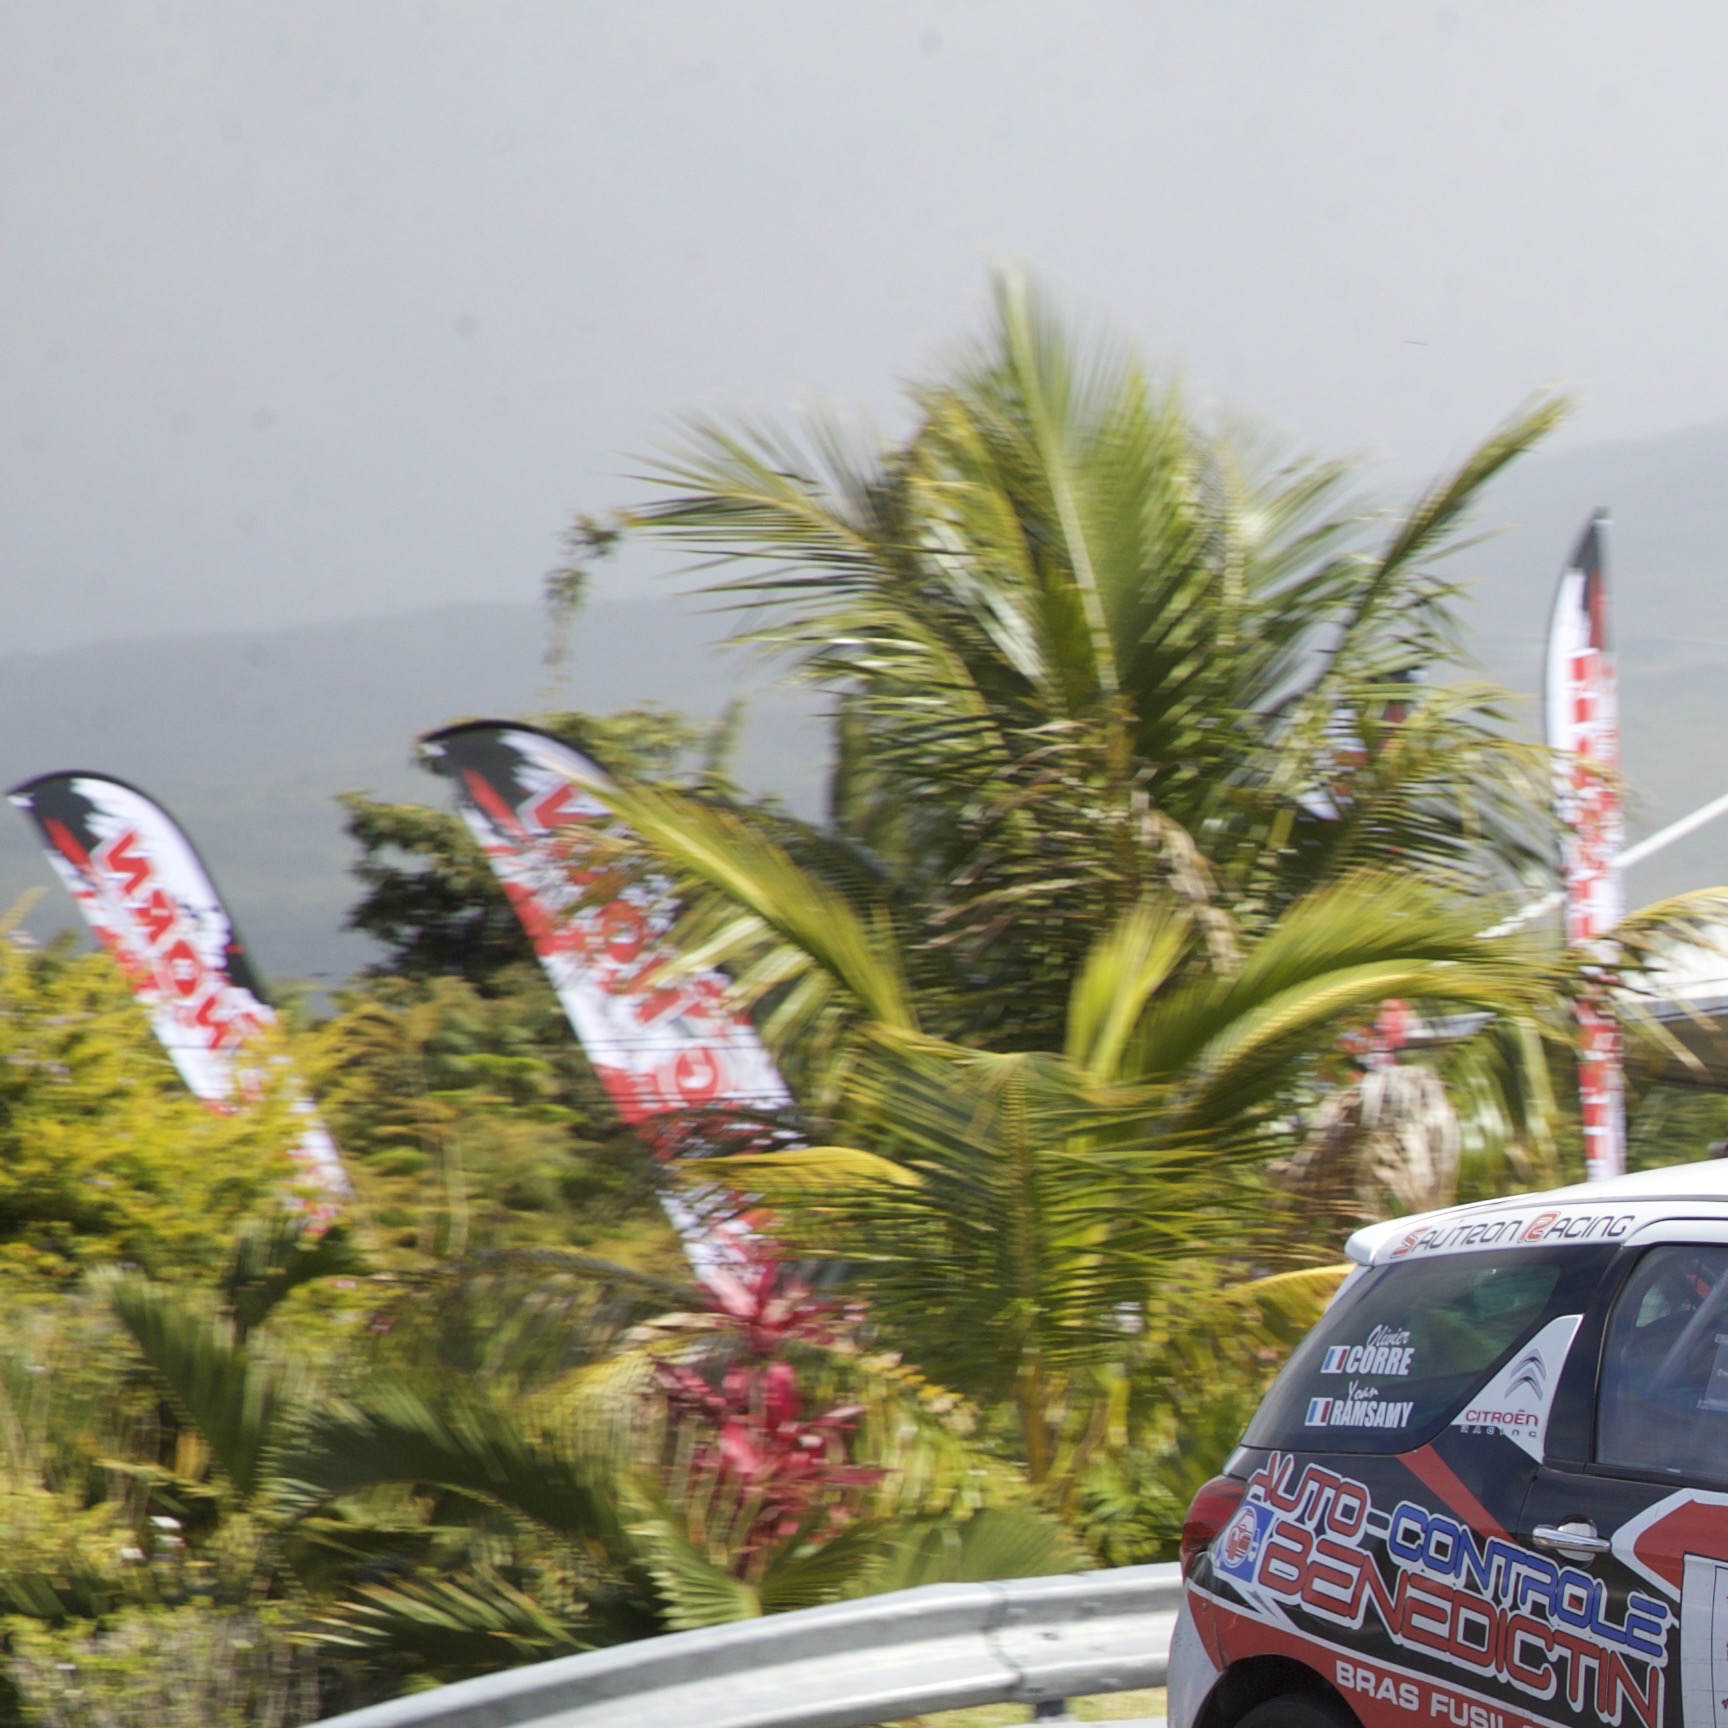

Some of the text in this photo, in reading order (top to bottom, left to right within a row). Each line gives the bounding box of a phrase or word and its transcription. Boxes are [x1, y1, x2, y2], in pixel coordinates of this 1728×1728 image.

[1367, 1324, 1411, 1348] Olivier
[1345, 1346, 1415, 1375] CORRE
[1330, 1399, 1414, 1428] RAMSAMY
[1465, 1409, 1539, 1426] CITROËN
[1336, 1660, 1419, 1711] BRAS
